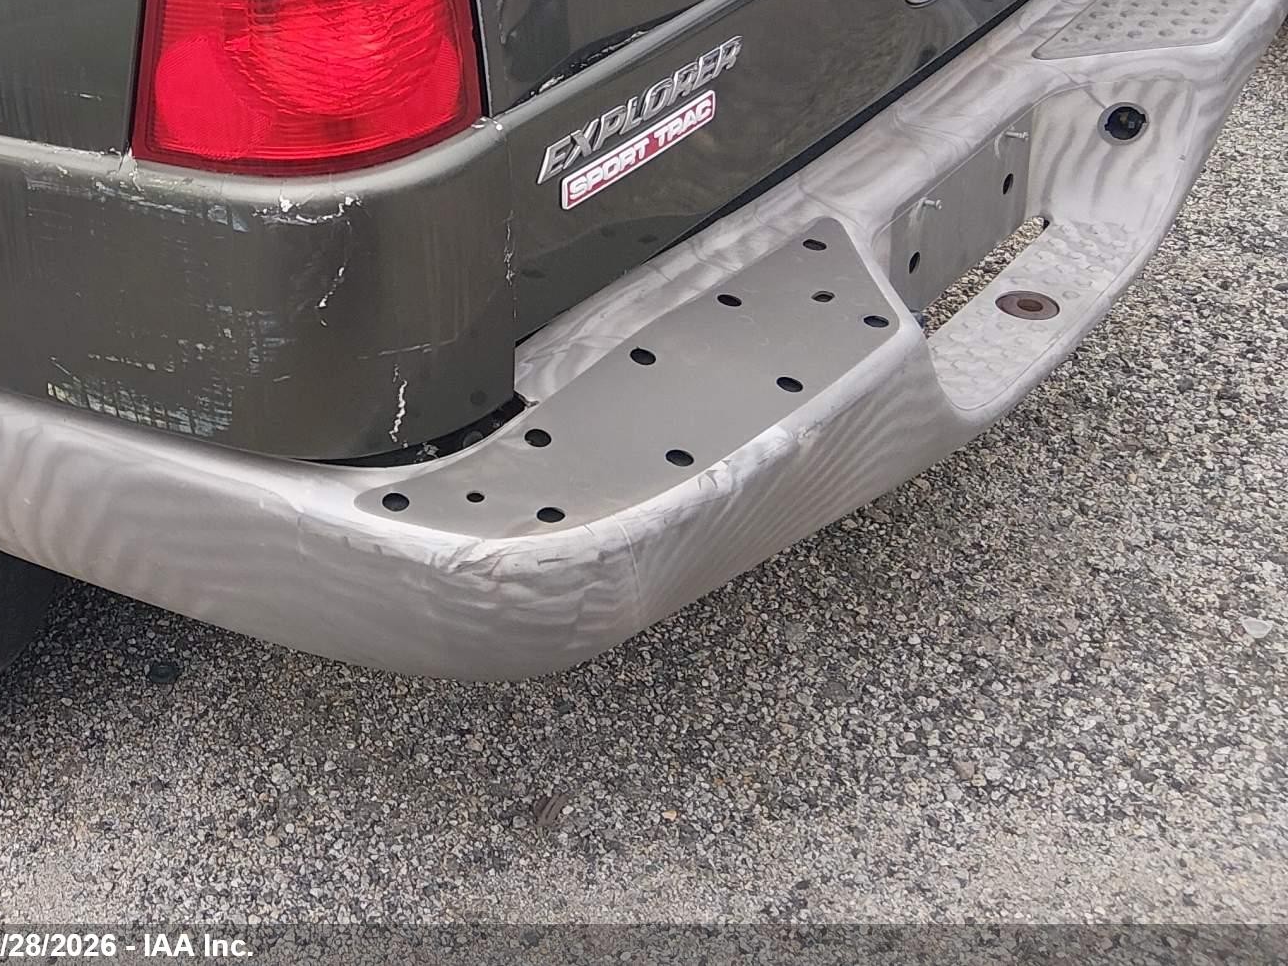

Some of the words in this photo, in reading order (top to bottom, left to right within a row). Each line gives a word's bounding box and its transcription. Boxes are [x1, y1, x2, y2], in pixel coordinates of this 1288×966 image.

[536, 35, 744, 185] EXPLORER
[568, 137, 650, 201] SPORT
[653, 98, 713, 148] TRAC
